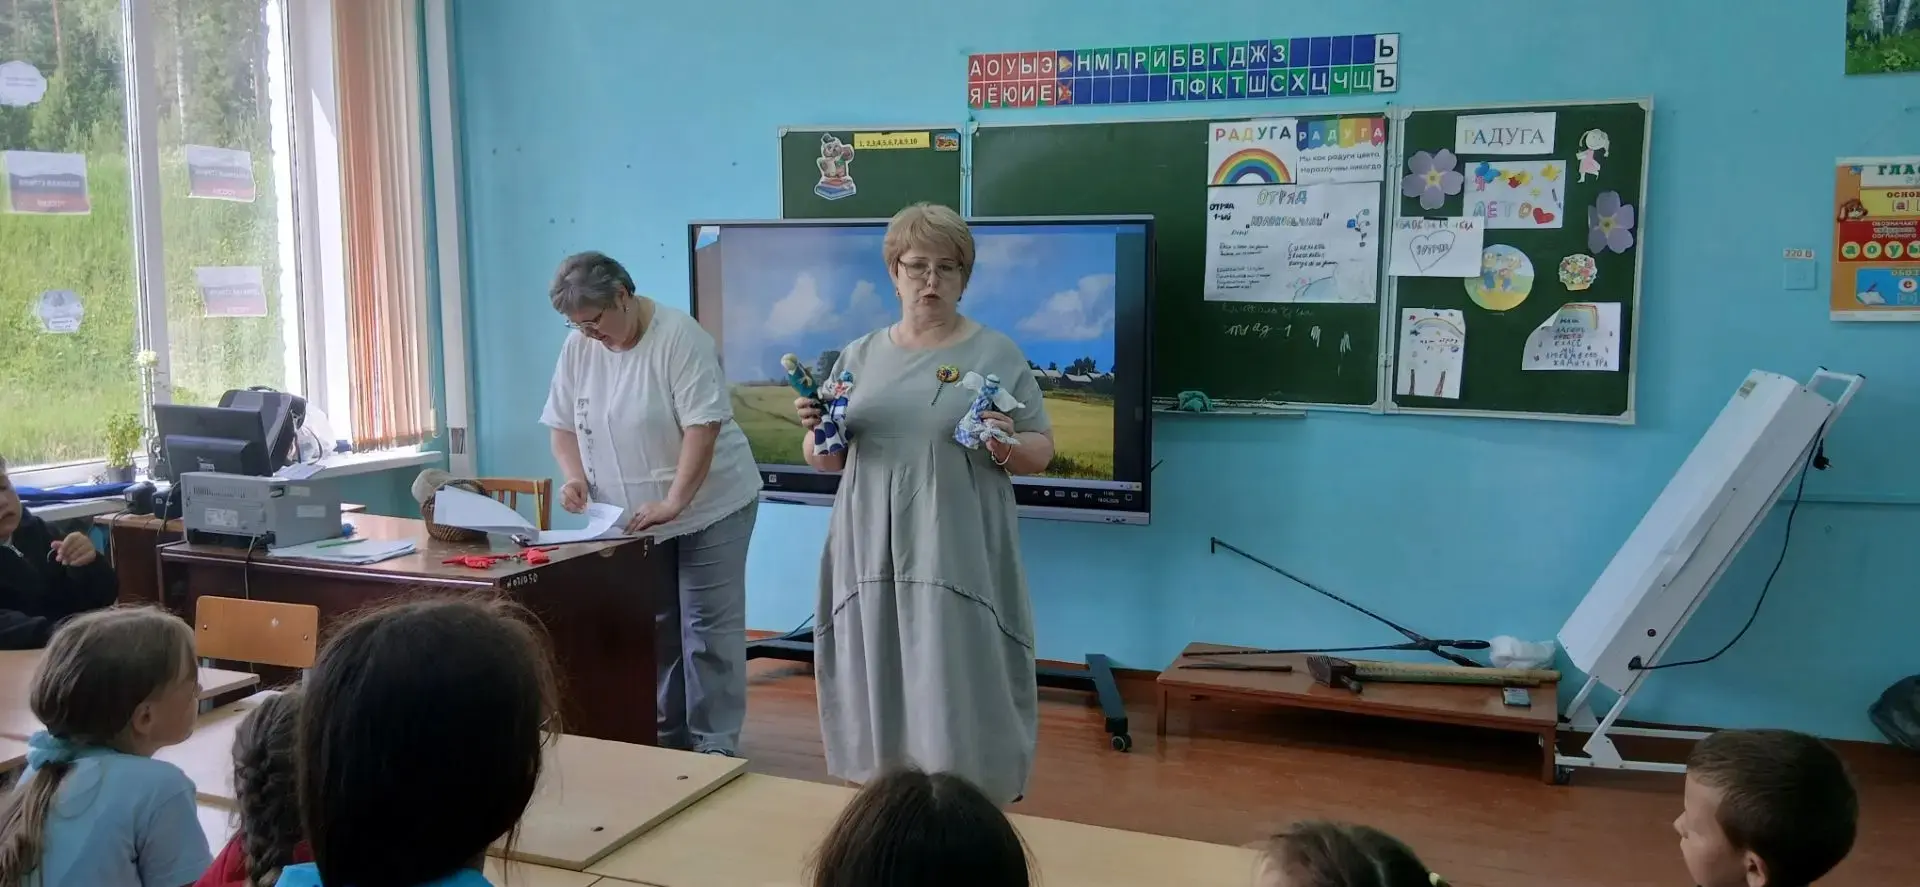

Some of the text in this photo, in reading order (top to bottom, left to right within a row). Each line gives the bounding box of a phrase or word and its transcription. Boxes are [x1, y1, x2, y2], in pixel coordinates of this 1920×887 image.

[1380, 37, 1394, 58] Ь
[1376, 69, 1395, 88] Ъ
[1215, 125, 1291, 142] РАДУГА
[1299, 127, 1383, 142] РАДУГА
[1463, 127, 1545, 148] РАДУГА
[1328, 153, 1355, 162] радуги
[1257, 188, 1308, 206] ОТРЯД
[1472, 200, 1533, 219] ЛЕТО
[1785, 249, 1803, 257] 220
